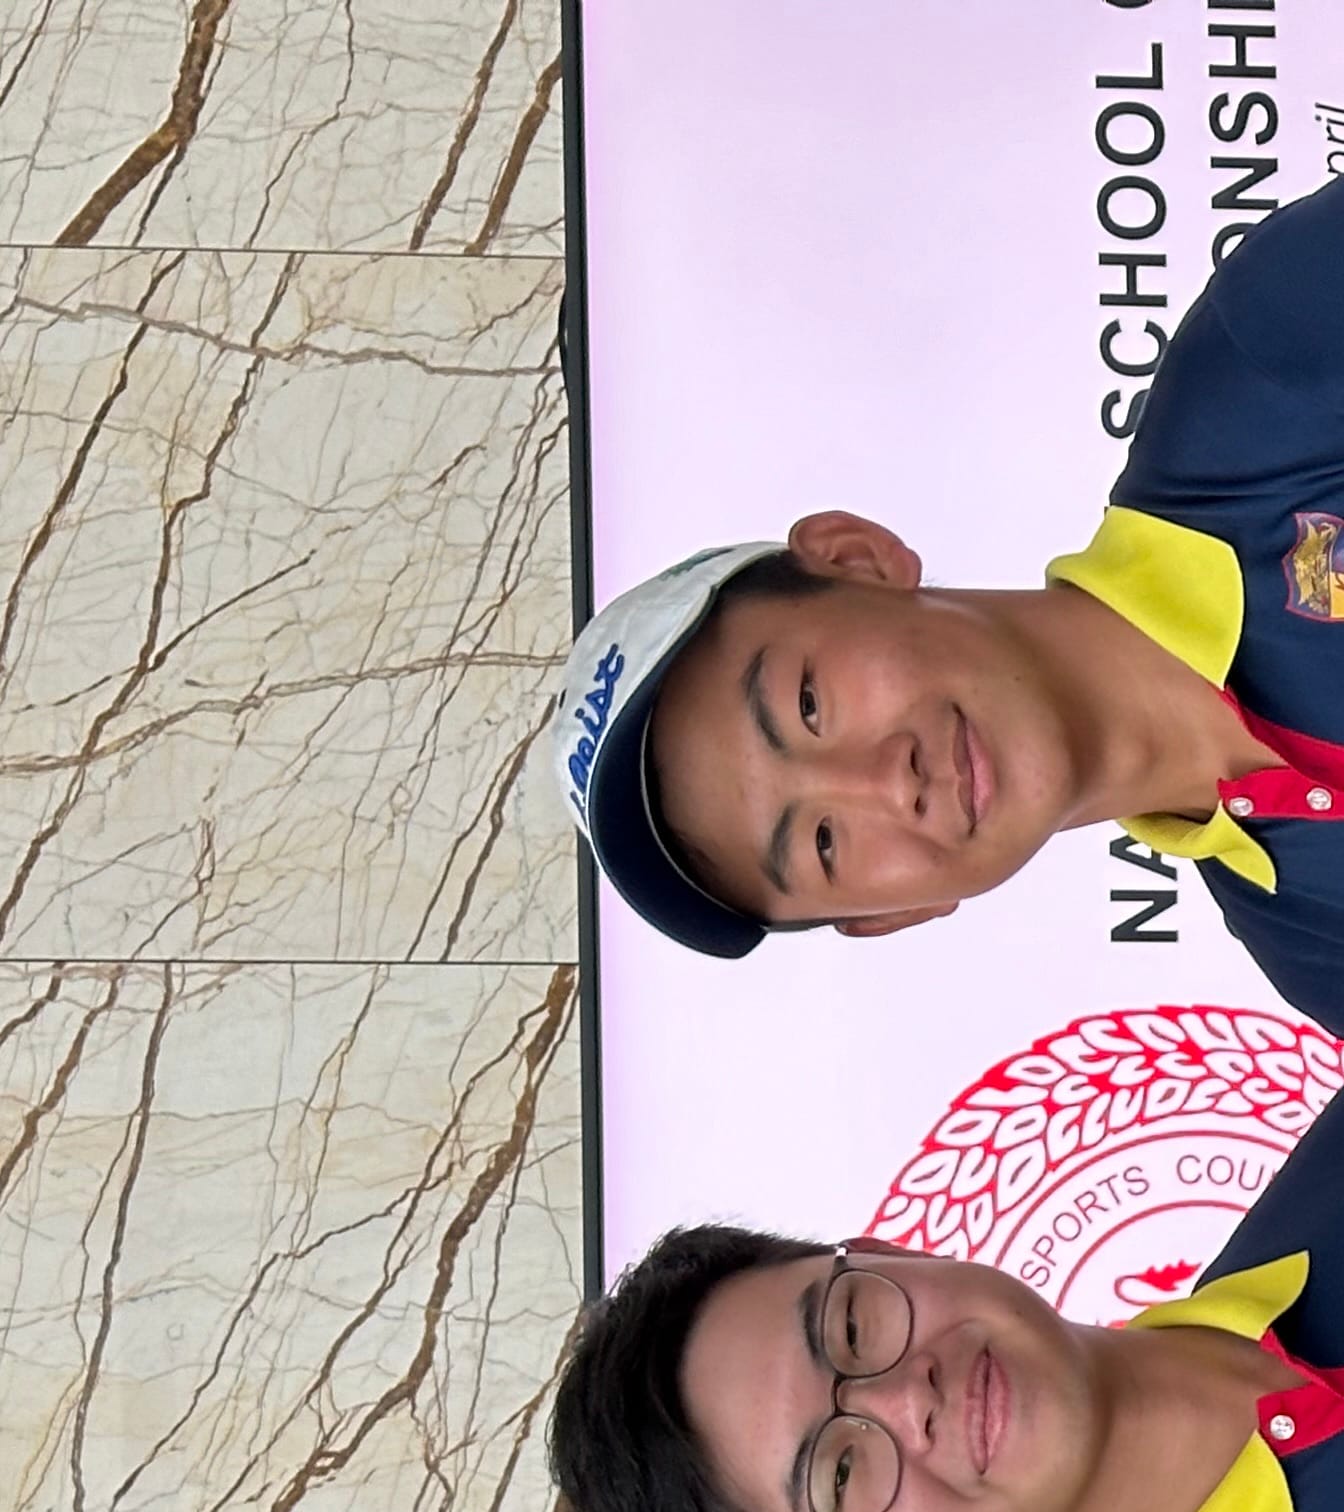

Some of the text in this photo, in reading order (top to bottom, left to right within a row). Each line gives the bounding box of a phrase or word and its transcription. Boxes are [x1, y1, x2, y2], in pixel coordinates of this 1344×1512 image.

[1095, 41, 1168, 440] SCHOOL
[568, 643, 625, 828] leist
[1108, 835, 1178, 943] NA
[1019, 1154, 1274, 1288] SPORTS COU
